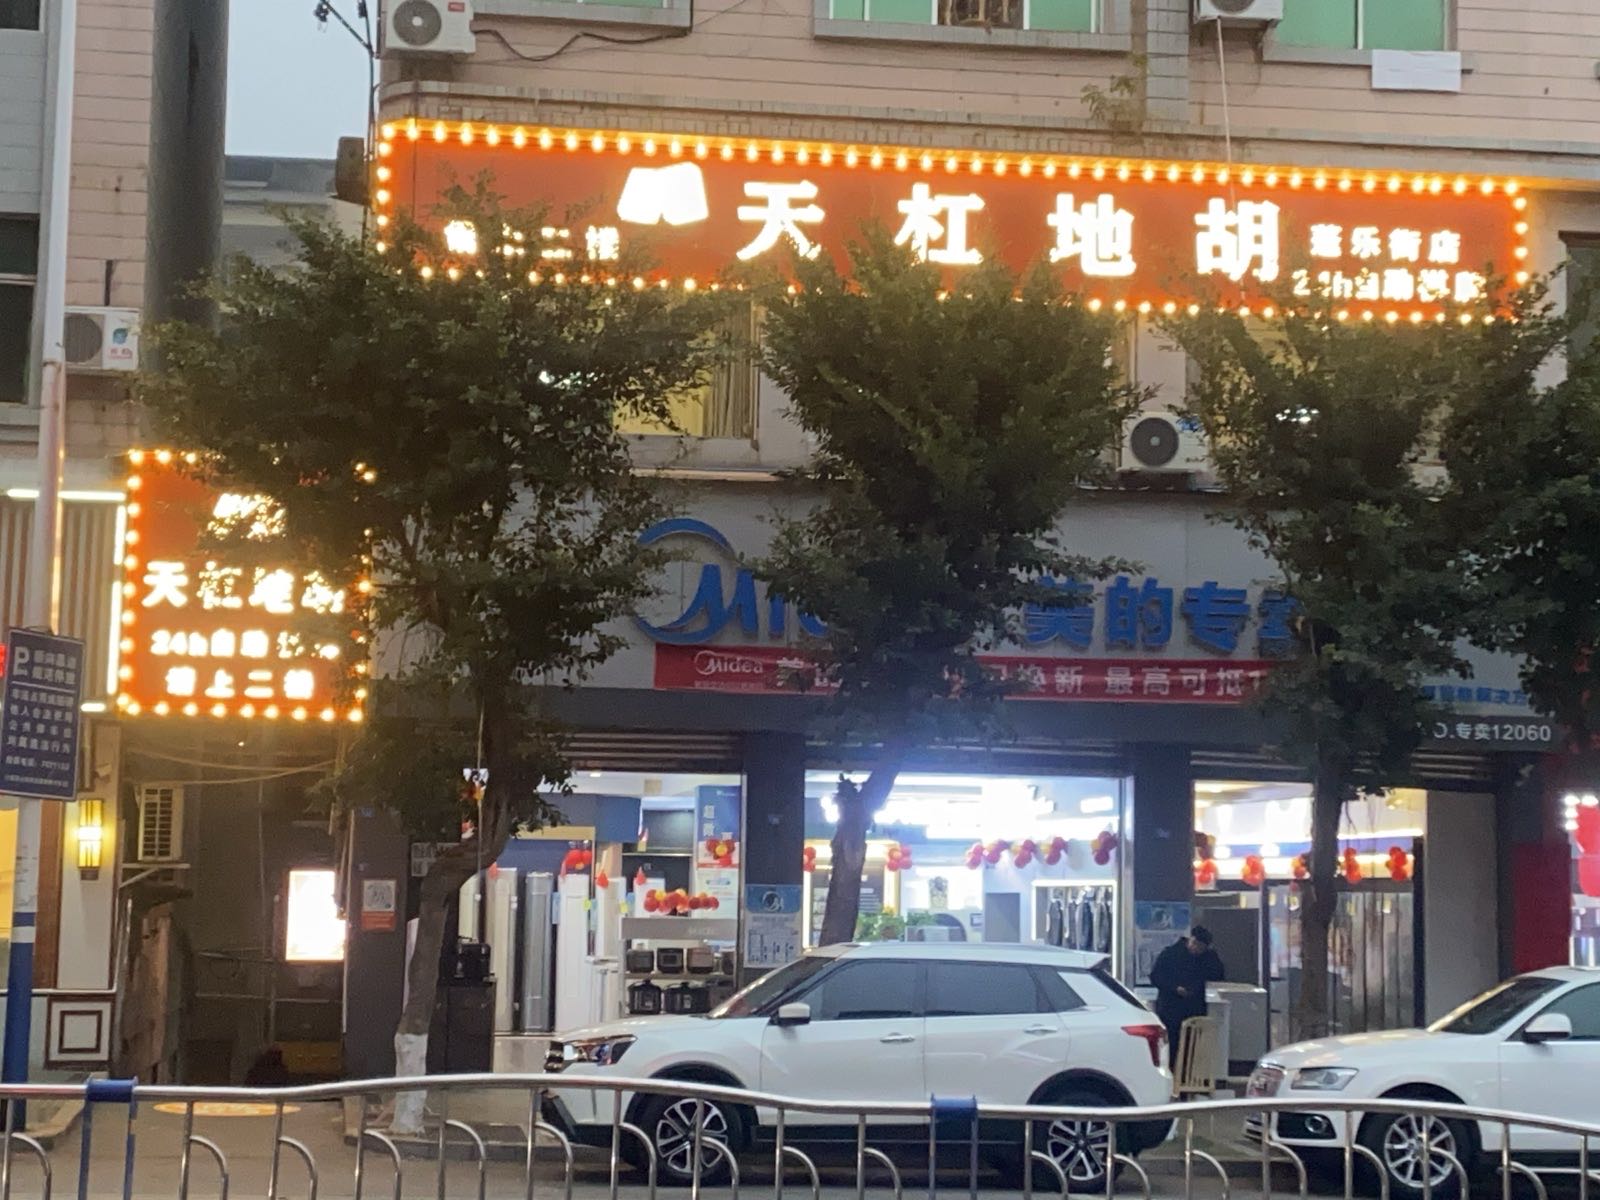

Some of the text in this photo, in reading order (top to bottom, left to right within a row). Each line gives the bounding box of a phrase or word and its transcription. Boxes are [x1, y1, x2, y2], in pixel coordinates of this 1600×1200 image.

[736, 180, 1280, 282] 天杠地胡
[694, 650, 764, 675] Midea
